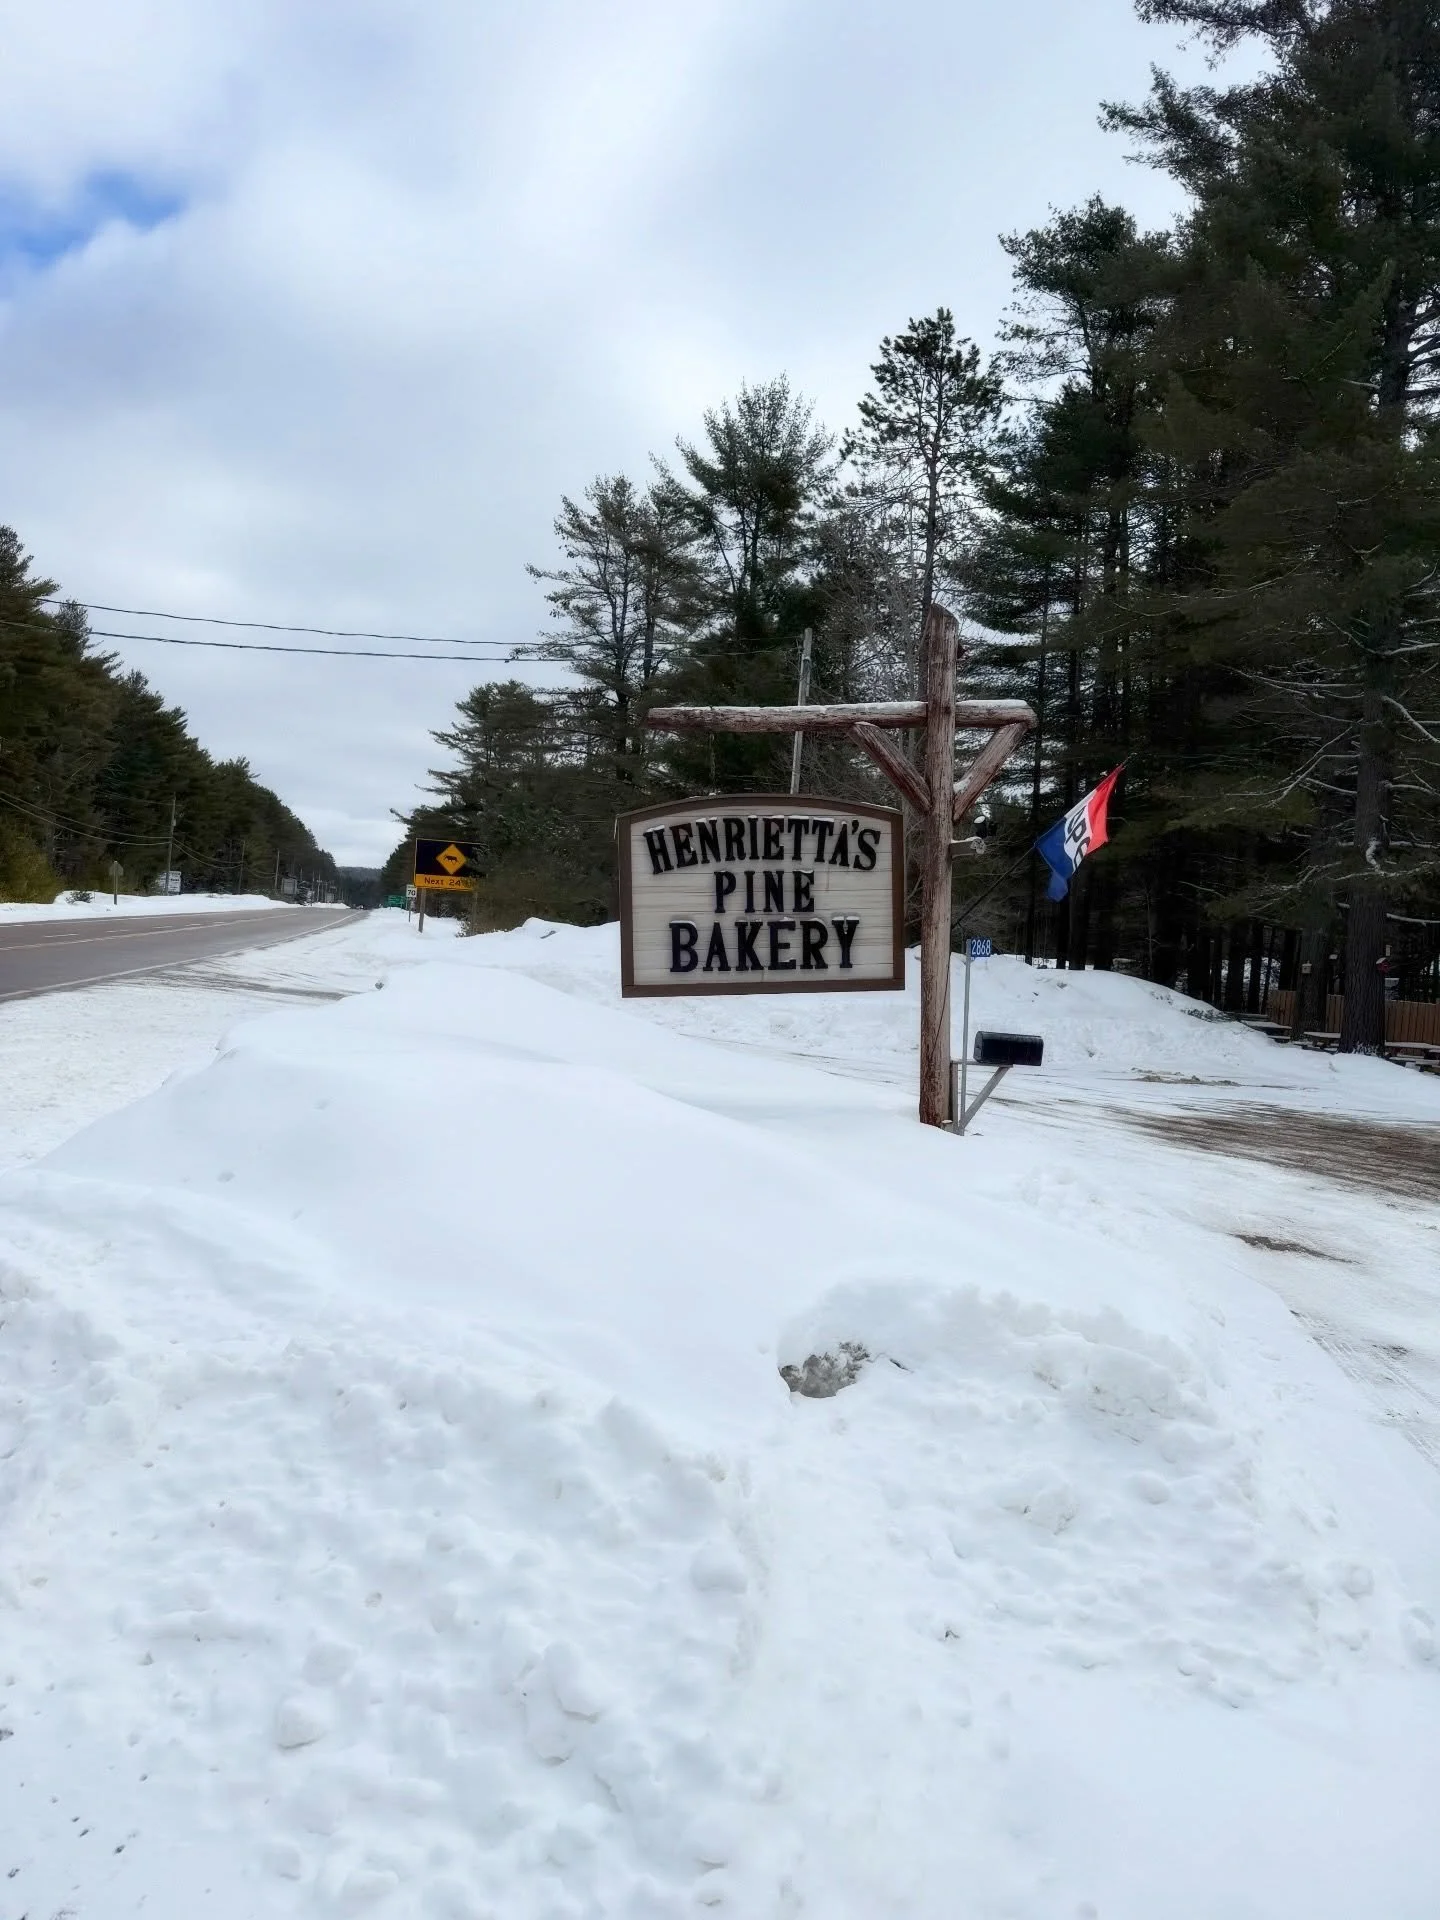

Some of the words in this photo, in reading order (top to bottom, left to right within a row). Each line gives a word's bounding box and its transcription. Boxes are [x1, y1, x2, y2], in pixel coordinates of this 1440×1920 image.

[642, 815, 881, 875] HENRIETTA'S
[424, 877, 444, 886] Next
[448, 879, 461, 887] 24
[714, 871, 815, 914] PINE
[669, 918, 860, 973] BAKERY
[971, 939, 991, 956] 2868
